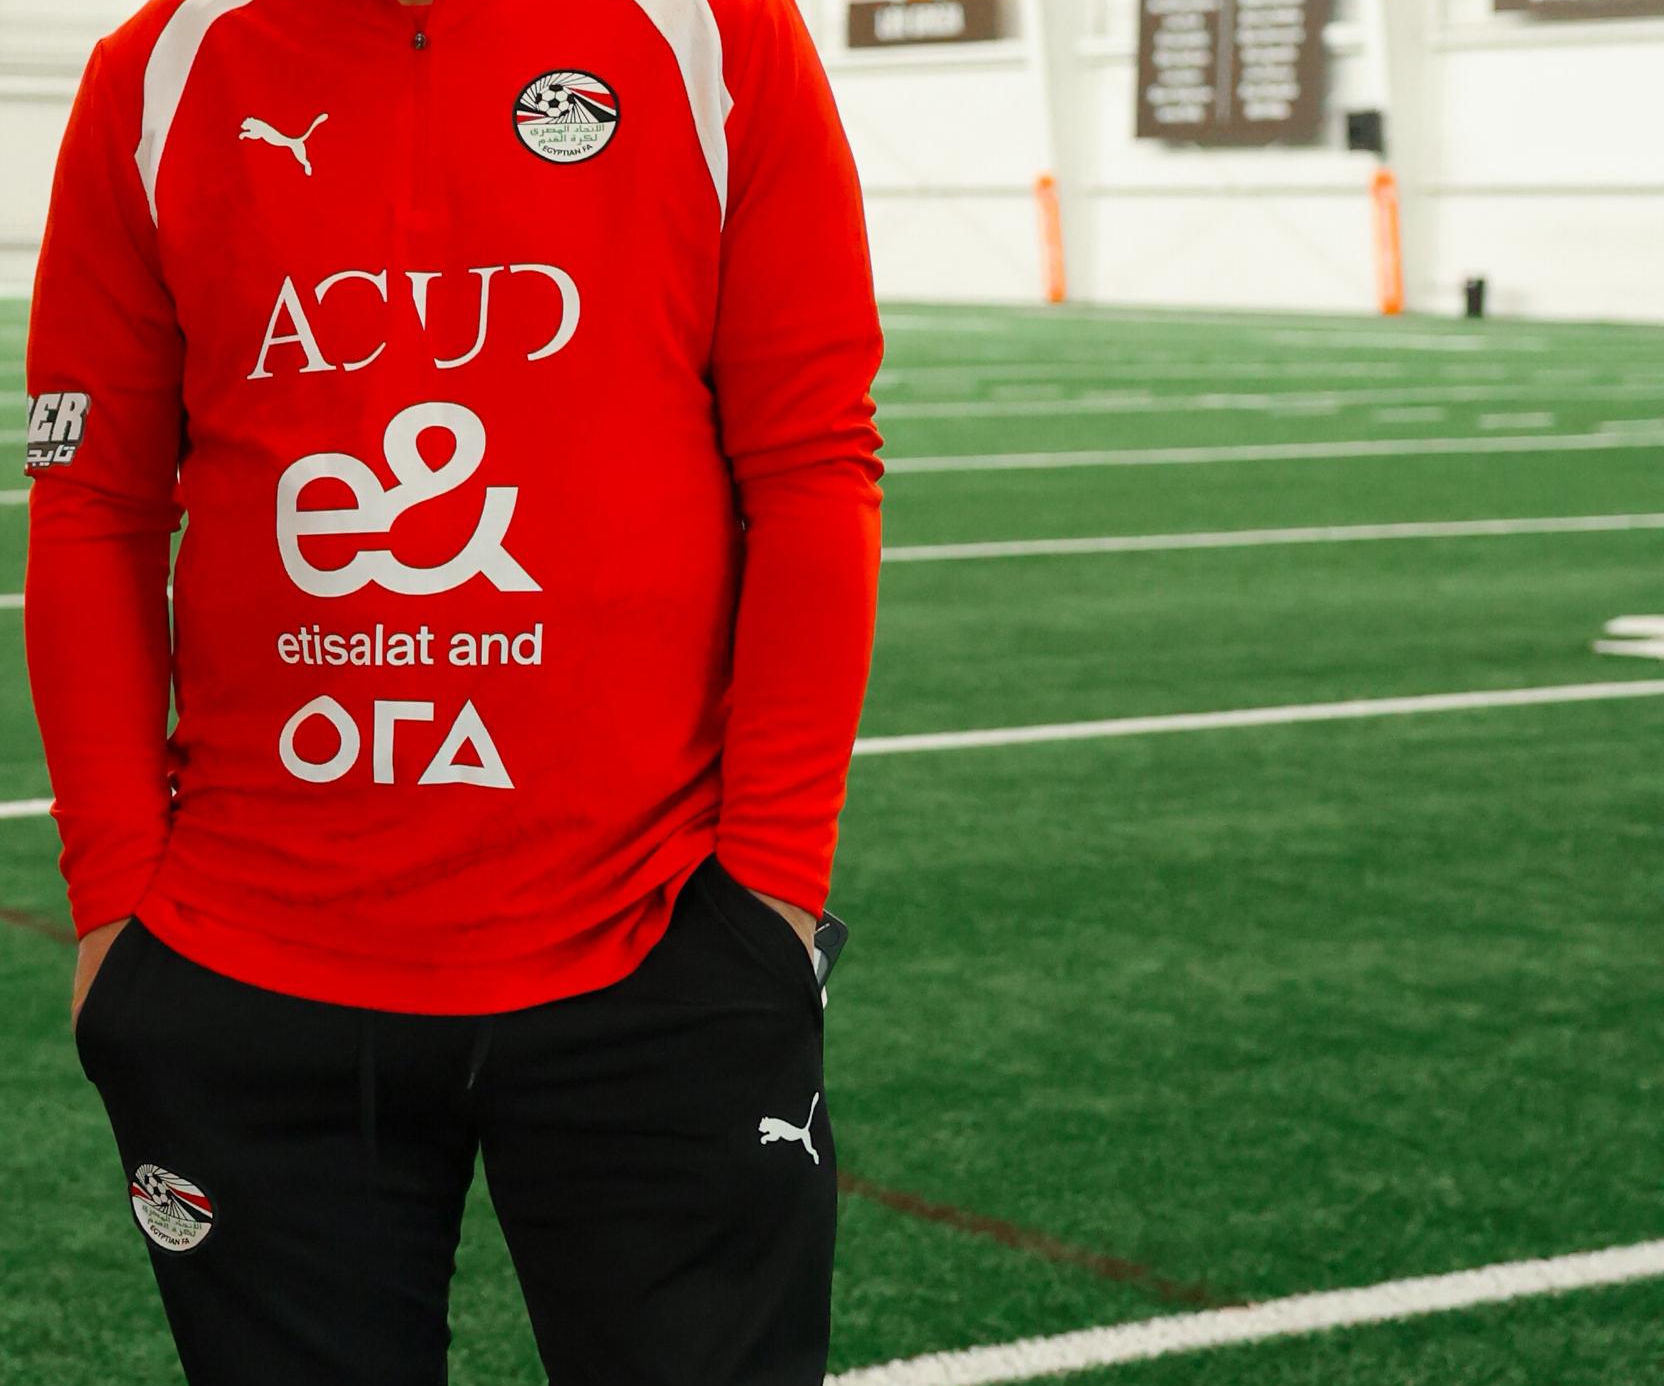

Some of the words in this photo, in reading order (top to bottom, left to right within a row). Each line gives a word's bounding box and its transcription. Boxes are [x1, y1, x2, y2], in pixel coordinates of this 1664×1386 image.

[542, 145, 582, 157] EGYPTIAN
[582, 143, 593, 153] FA
[27, 392, 88, 443] ER
[277, 624, 434, 666] etisalat
[448, 623, 543, 666] and
[150, 1225, 180, 1245] EGYPTIAN
[181, 1237, 191, 1245] FA
